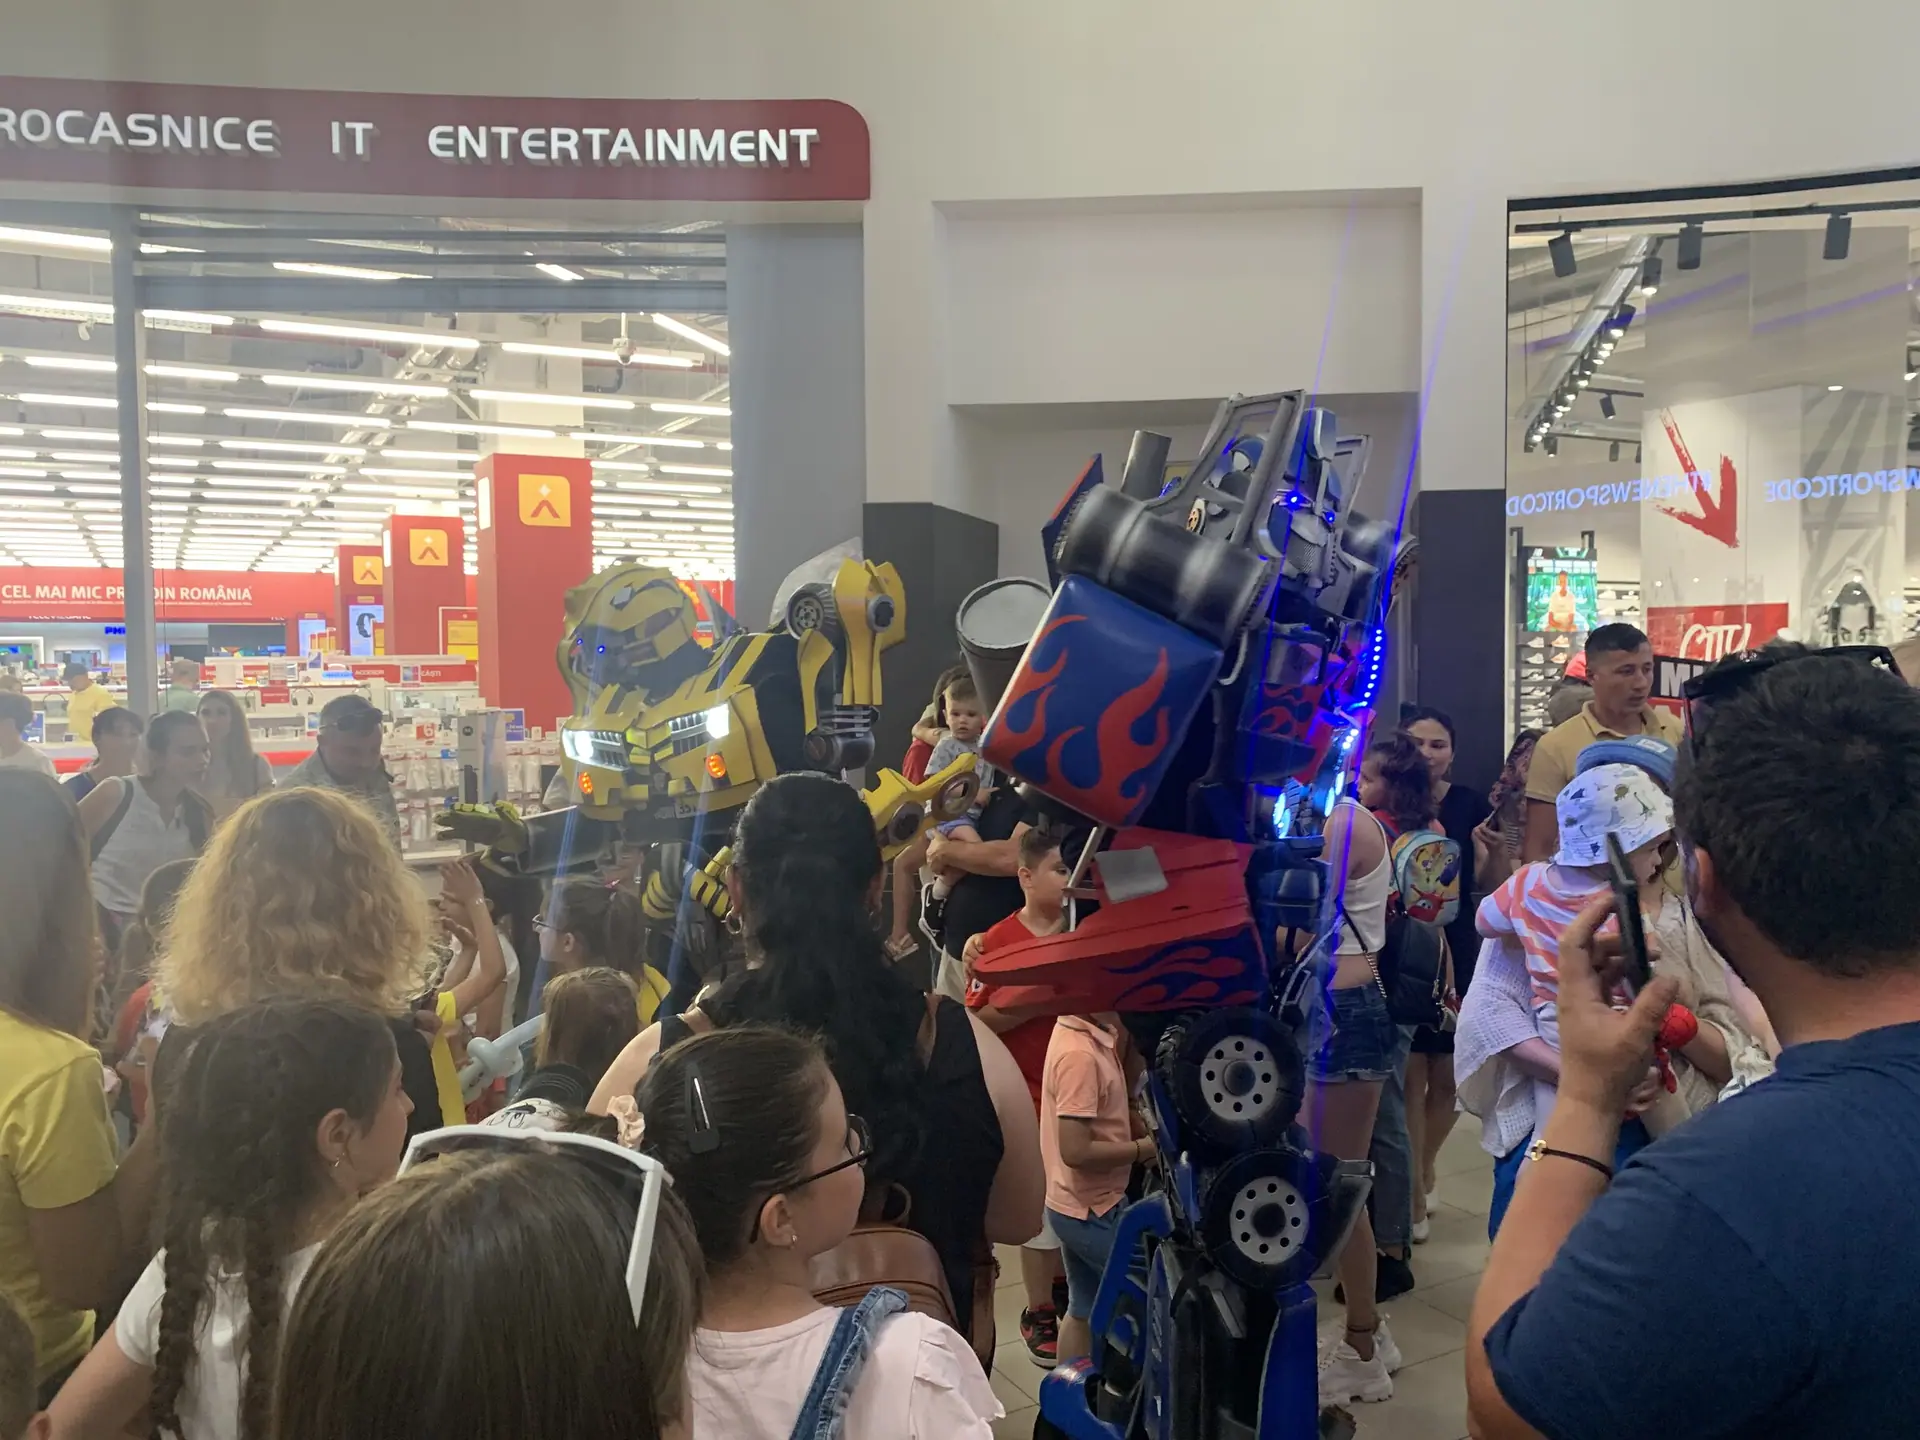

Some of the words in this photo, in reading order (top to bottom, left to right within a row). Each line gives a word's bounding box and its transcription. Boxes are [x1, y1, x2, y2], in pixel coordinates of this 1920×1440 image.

[331, 121, 374, 155] IT
[428, 125, 819, 163] ENTERTAINMENT
[1, 584, 31, 599] CEL
[35, 585, 67, 599] MAI
[71, 586, 102, 600] MIC
